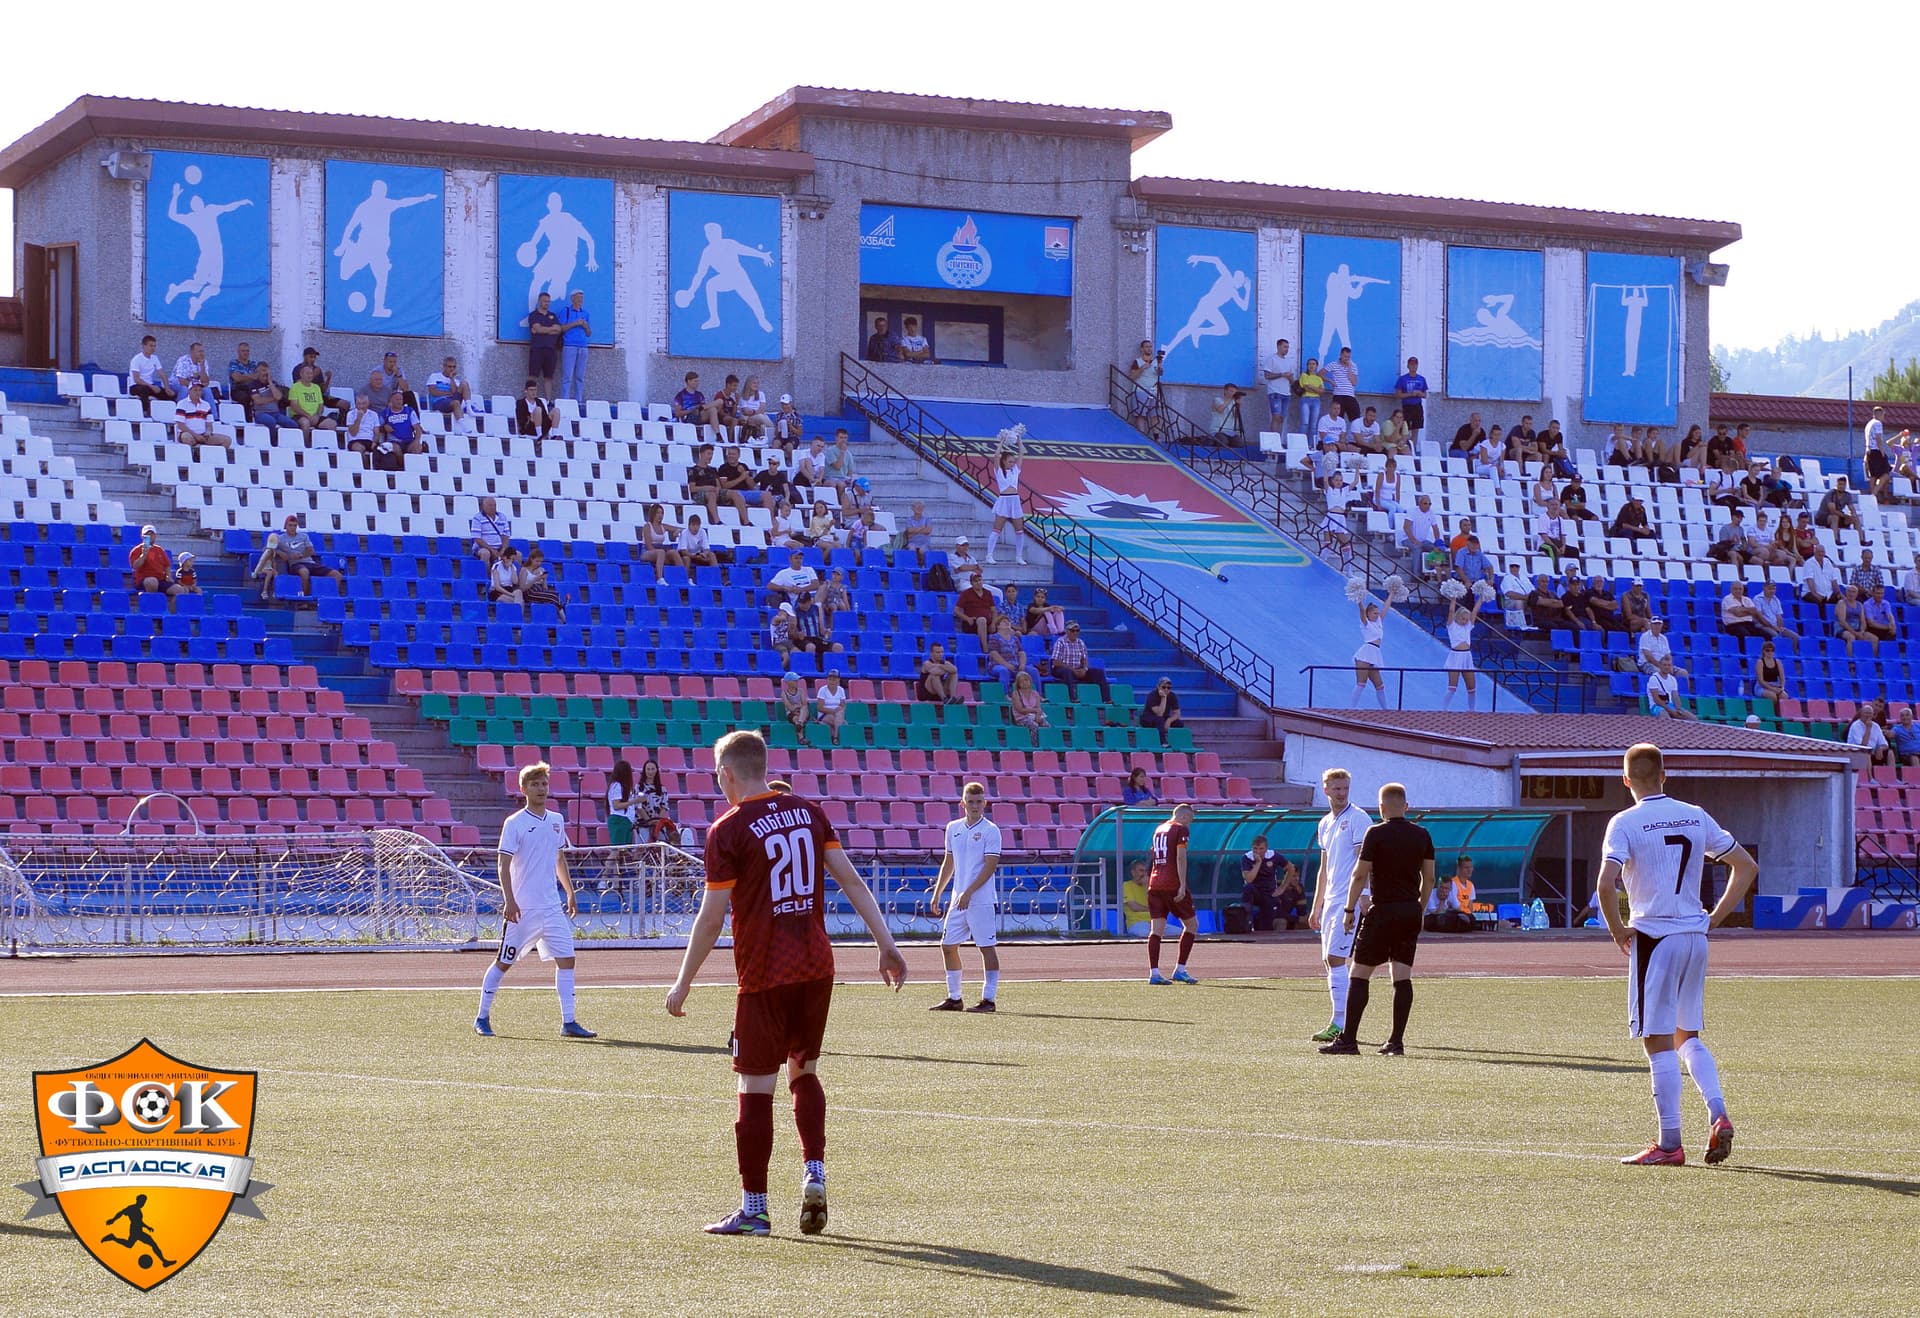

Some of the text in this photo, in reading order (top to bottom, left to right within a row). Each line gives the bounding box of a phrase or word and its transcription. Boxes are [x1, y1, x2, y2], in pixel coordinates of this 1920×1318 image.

[860, 236, 896, 247] УЗБАСС
[749, 808, 812, 839] БОБЕШКО
[1153, 832, 1168, 858] 44
[764, 827, 815, 903] 20
[1664, 834, 1693, 895] 7
[1815, 905, 1824, 927] 2
[1861, 903, 1868, 926] 1
[1905, 911, 1914, 928] 3
[503, 944, 516, 960] 19
